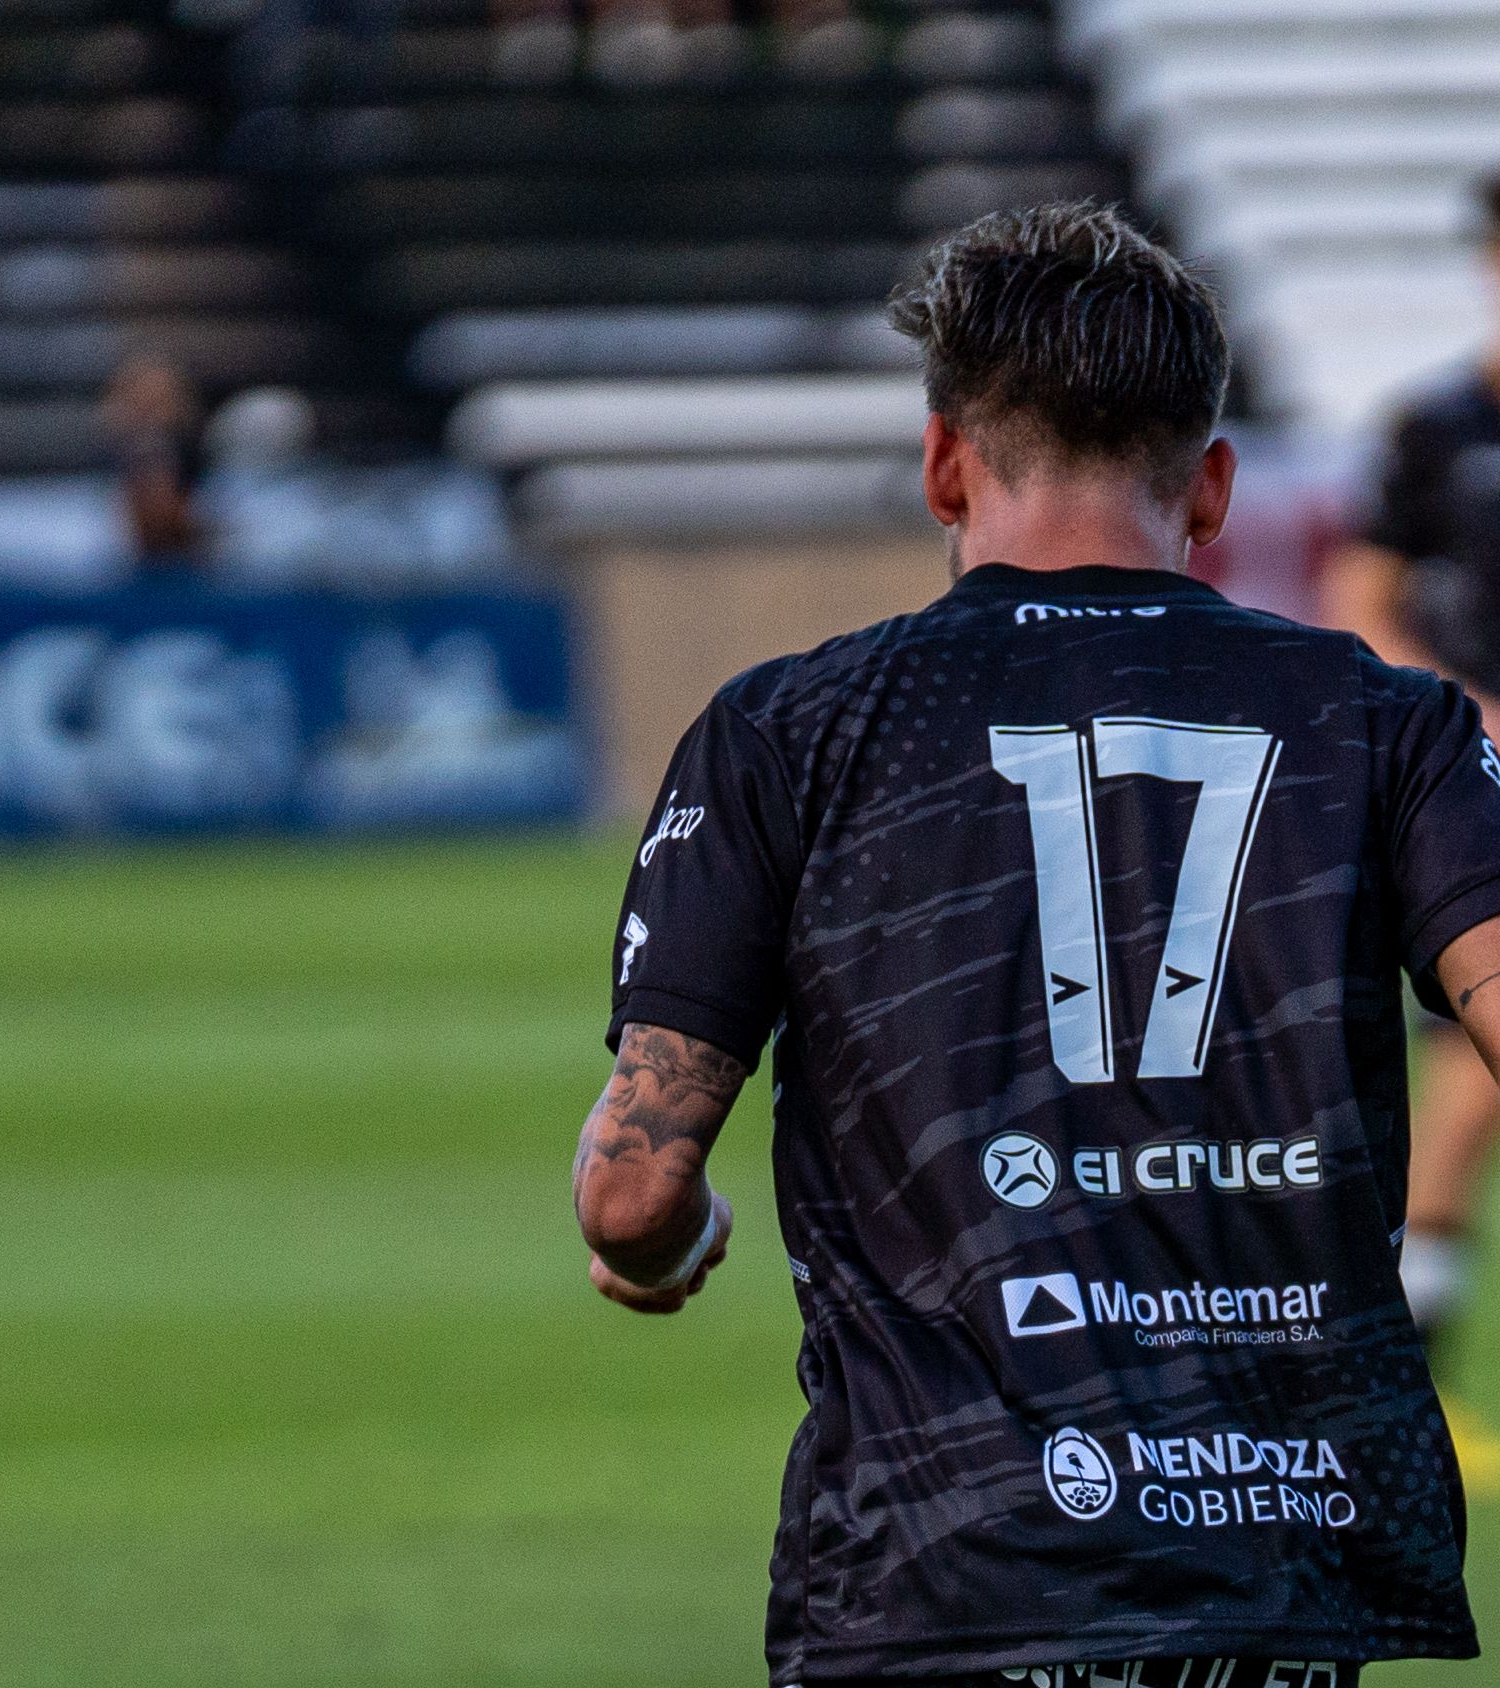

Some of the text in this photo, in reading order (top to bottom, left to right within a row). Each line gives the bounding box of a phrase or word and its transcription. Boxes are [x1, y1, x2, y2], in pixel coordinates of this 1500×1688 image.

[989, 717, 1283, 1083] 17
[1089, 1280, 1328, 1326] Montemar
[1213, 1327, 1286, 1345] Financiera
[1290, 1325, 1324, 1342] S.A.
[1127, 1432, 1346, 1480] MENDOZA
[1139, 1484, 1356, 1528] GOBIERNO
